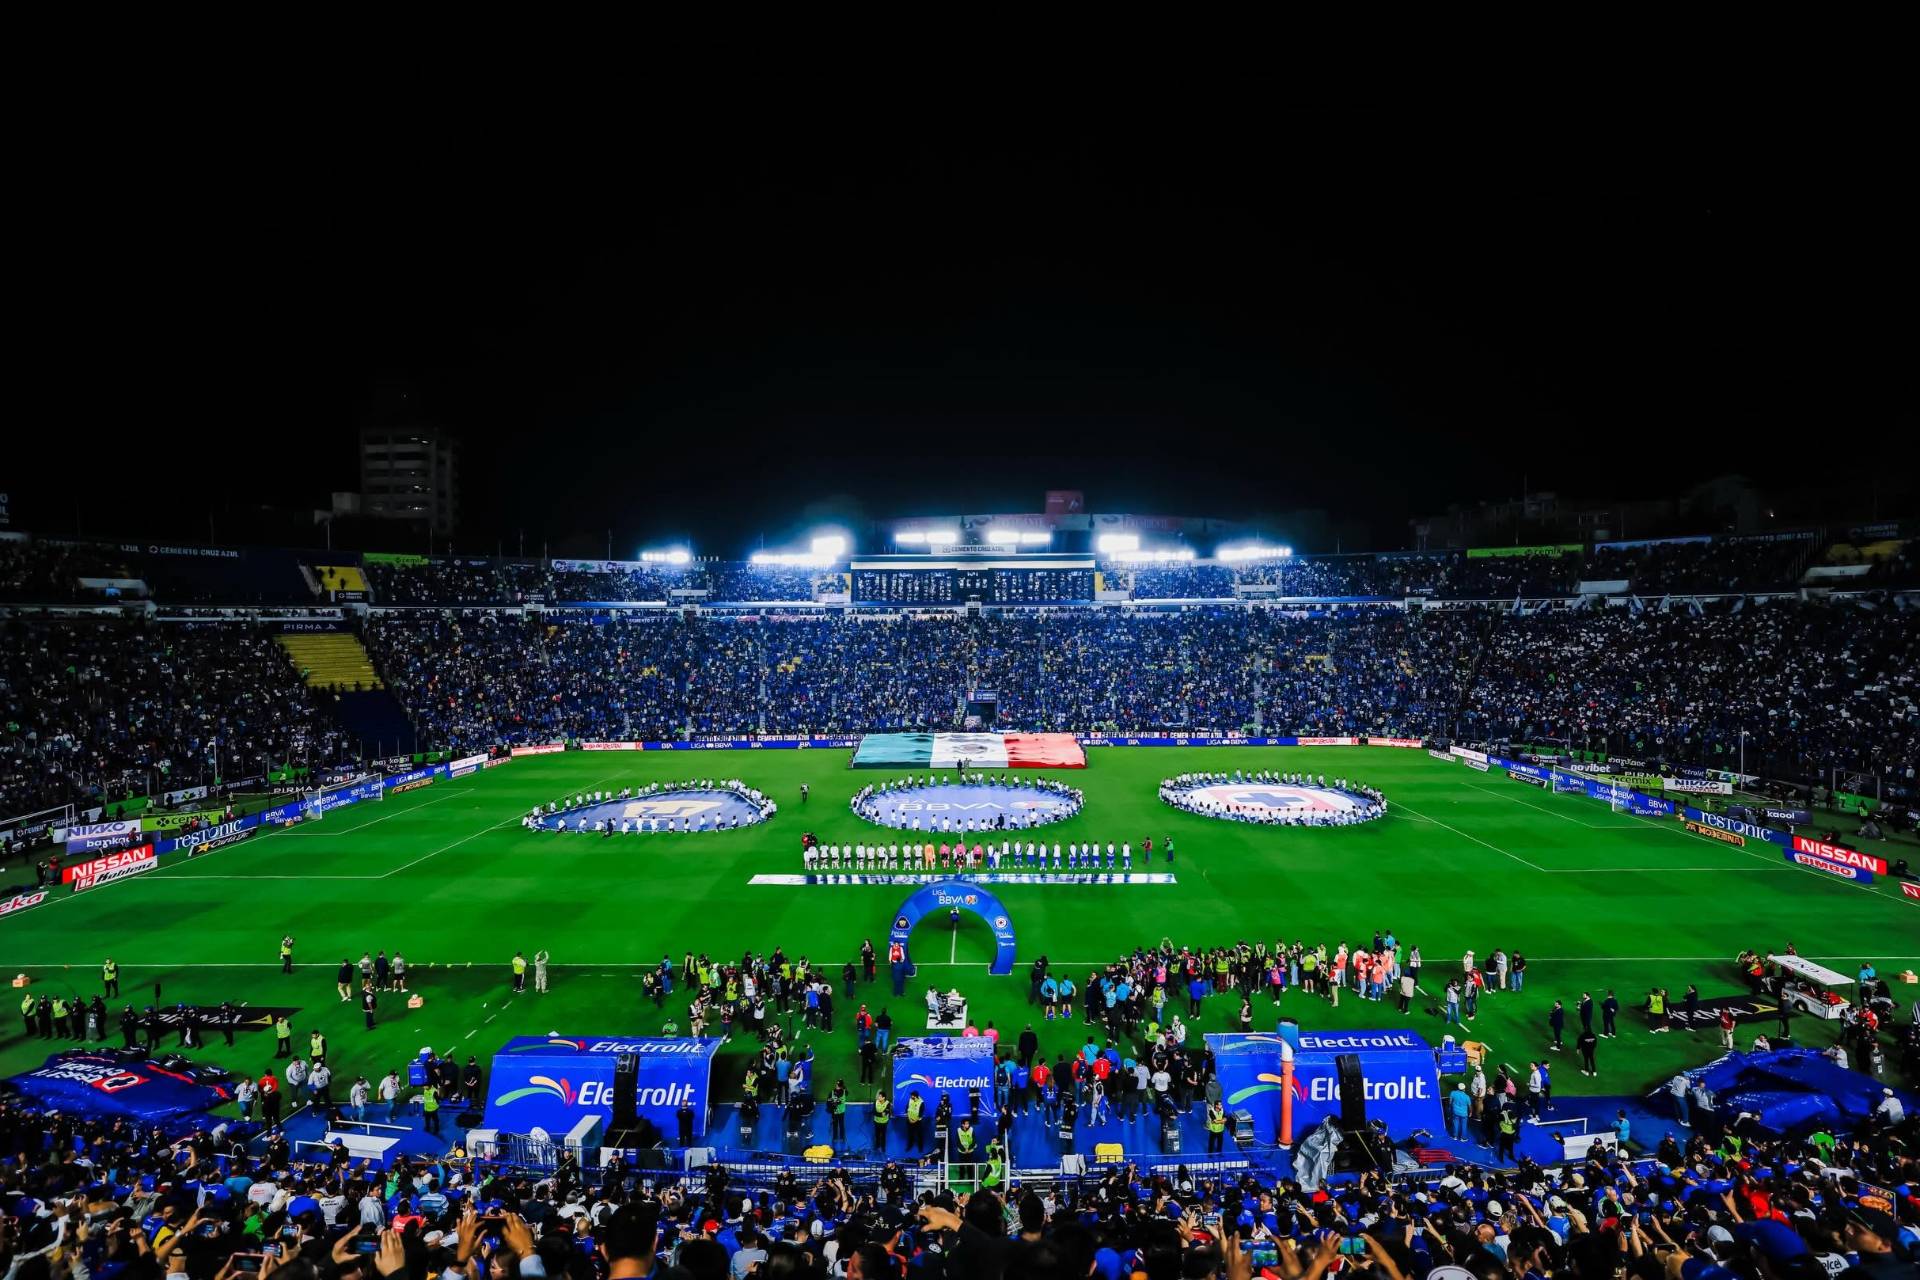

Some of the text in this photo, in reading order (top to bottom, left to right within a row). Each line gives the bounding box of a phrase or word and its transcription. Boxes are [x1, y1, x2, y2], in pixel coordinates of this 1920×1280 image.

[273, 785, 313, 794] PIRMA
[899, 802, 1003, 811] BBVA
[1648, 800, 1668, 811] BBVA
[68, 822, 126, 837] NIKKO
[1801, 838, 1878, 872] NISSAN
[72, 847, 146, 880] NISSAN
[1798, 855, 1852, 876] BIMBO
[96, 862, 153, 883] Koblenz
[939, 896, 964, 905] BBVA
[589, 1041, 705, 1053] Electrolit
[1300, 1034, 1415, 1049] Electrolit
[935, 1076, 990, 1088] Electrolit
[1311, 1076, 1431, 1101] Eletrolit
[578, 1081, 696, 1106] Eletrolit
